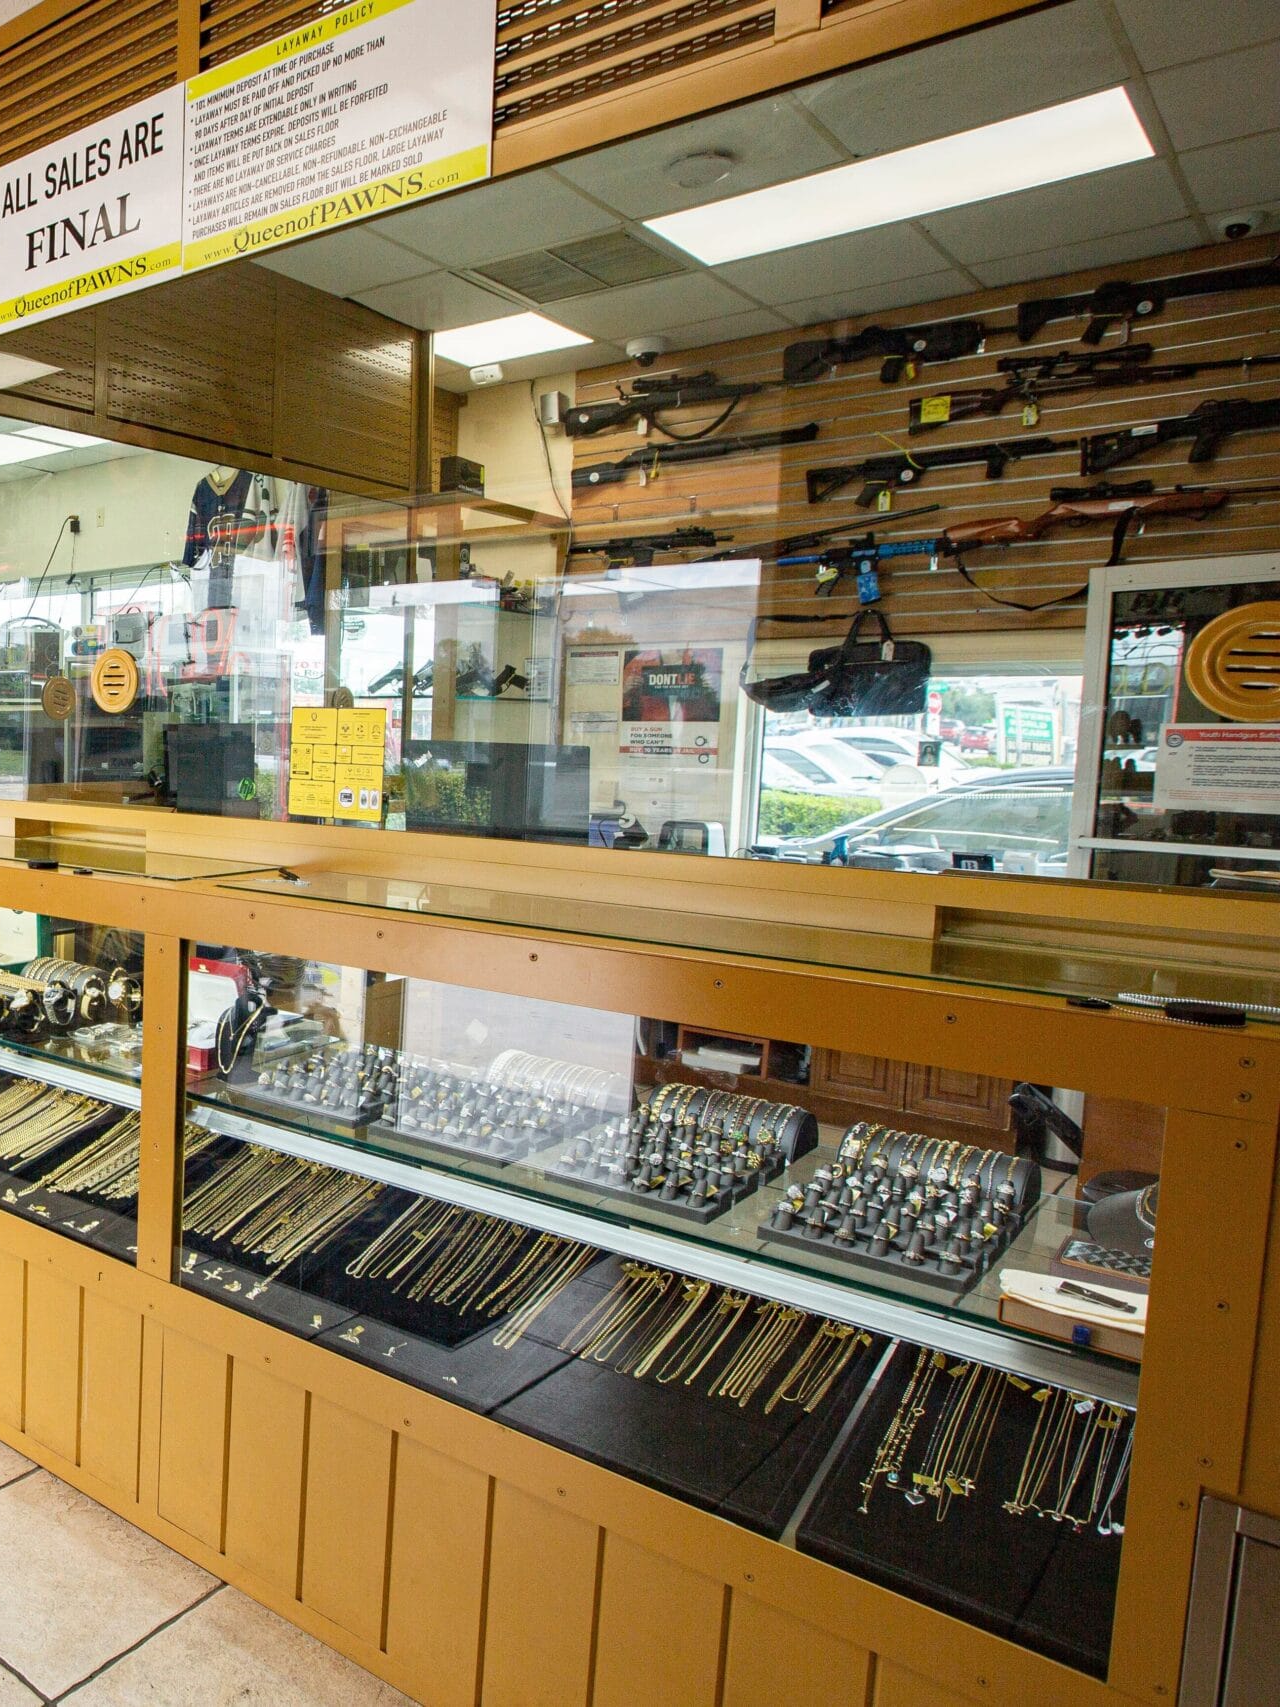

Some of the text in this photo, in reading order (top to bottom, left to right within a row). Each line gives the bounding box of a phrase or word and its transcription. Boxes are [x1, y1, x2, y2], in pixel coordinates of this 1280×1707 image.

[276, 0, 374, 56] LAYAWAY POLICY
[195, 35, 384, 126] LAYAWAY MUST BE PAID OFF AND PICKED UP NO MORE THAN
[203, 121, 218, 136] DAYS
[220, 113, 238, 129] AFTER
[239, 107, 251, 121] DAY
[253, 103, 260, 116] OF
[263, 94, 284, 111] INITIAL
[286, 81, 313, 102] DEPOSIT
[206, 85, 234, 106] MINIMUM
[236, 73, 262, 94] DEPOSIT
[262, 69, 270, 82] AT
[271, 62, 287, 78] TIME
[288, 57, 297, 71] OF
[298, 41, 334, 66] PURCHASE
[194, 79, 357, 154] LAYAWAY TERMS ARE EXTENDABLE ONLY IN WRITING
[194, 154, 209, 168] ONCE
[210, 142, 238, 162] LAYAWAY
[240, 133, 260, 150] TERMS
[287, 110, 319, 132] DEPOSITS
[320, 103, 337, 119] WILL
[339, 98, 348, 111] BE
[350, 82, 388, 107] FORFEITED
[194, 118, 338, 183] AND ITEMS WILL BE PUT BACK ON SALES FLOOR
[2, 113, 163, 218] ALL SALES ARE
[193, 135, 335, 197] THERE ARE NO LAYAWAY OR SERVICE CHARGES
[25, 193, 141, 271] FINAL
